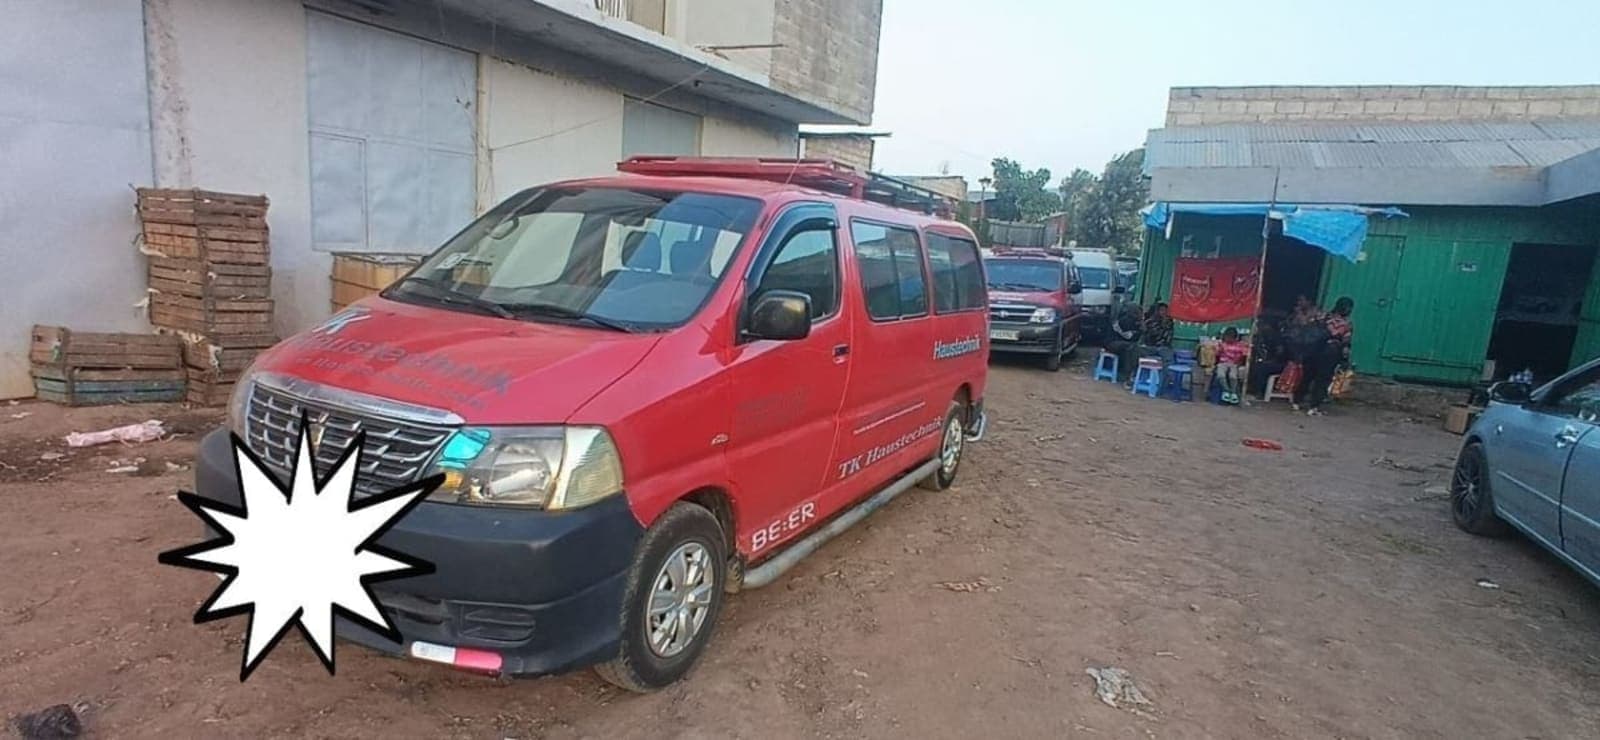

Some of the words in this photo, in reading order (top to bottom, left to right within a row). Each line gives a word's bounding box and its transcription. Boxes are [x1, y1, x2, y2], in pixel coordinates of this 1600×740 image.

[933, 334, 981, 360] Haustechnik
[839, 455, 864, 479] TK
[864, 415, 943, 467] Haustechnik
